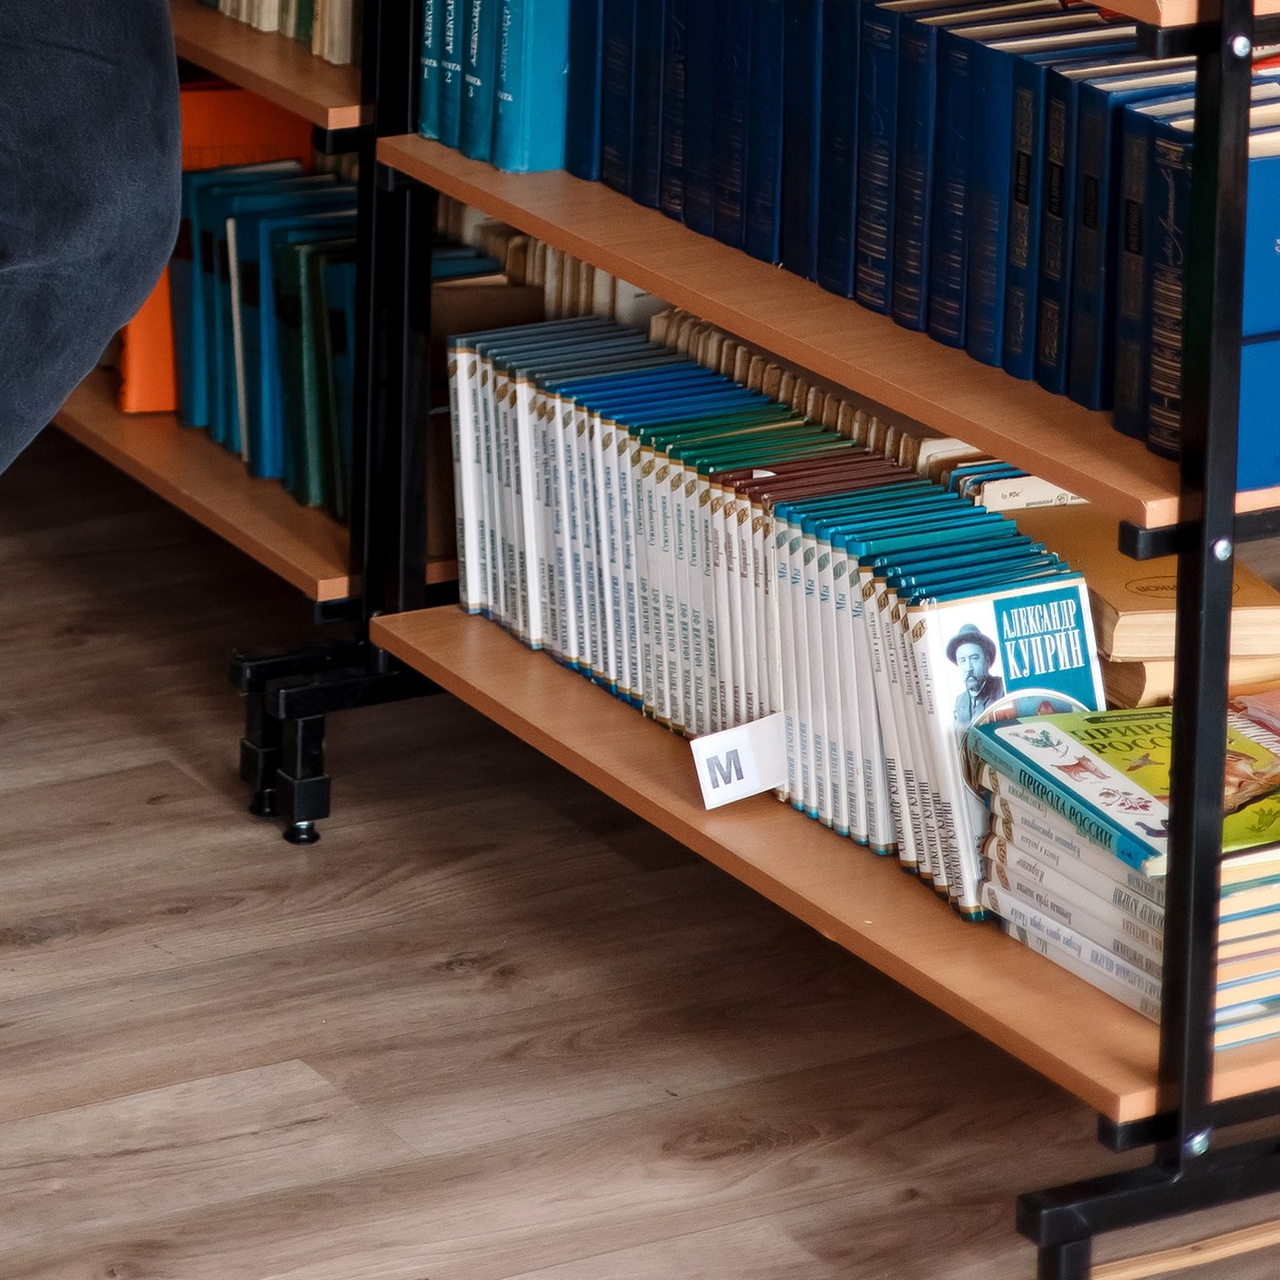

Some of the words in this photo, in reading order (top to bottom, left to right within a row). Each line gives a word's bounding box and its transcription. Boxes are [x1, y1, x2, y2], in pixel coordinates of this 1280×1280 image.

[444, 71, 452, 83] 2
[467, 85, 475, 98] 3
[778, 562, 787, 579] Мы
[791, 568, 801, 585] Мы
[651, 587, 660, 604] ФЕТ
[805, 578, 814, 596] Мы
[820, 584, 830, 602] Мы
[665, 594, 674, 611] ФЕТ
[835, 593, 846, 610] Мы
[852, 600, 862, 618] Мы
[869, 611, 880, 640] рассказы
[1002, 599, 1077, 640] АЛЕКСАНДР
[1005, 629, 1086, 680] КУПРИН
[885, 757, 899, 796] КУПРИН
[904, 769, 918, 807] КУПРИН
[918, 781, 933, 820] КУПРИН
[1019, 768, 1069, 814] ПРИРОДА
[1069, 804, 1114, 849] РОССИИ
[889, 798, 906, 854] АЛЕКСАНДР
[910, 809, 926, 866] АЛЕКСАНДР
[924, 822, 941, 879] АЛЕКСАНДР
